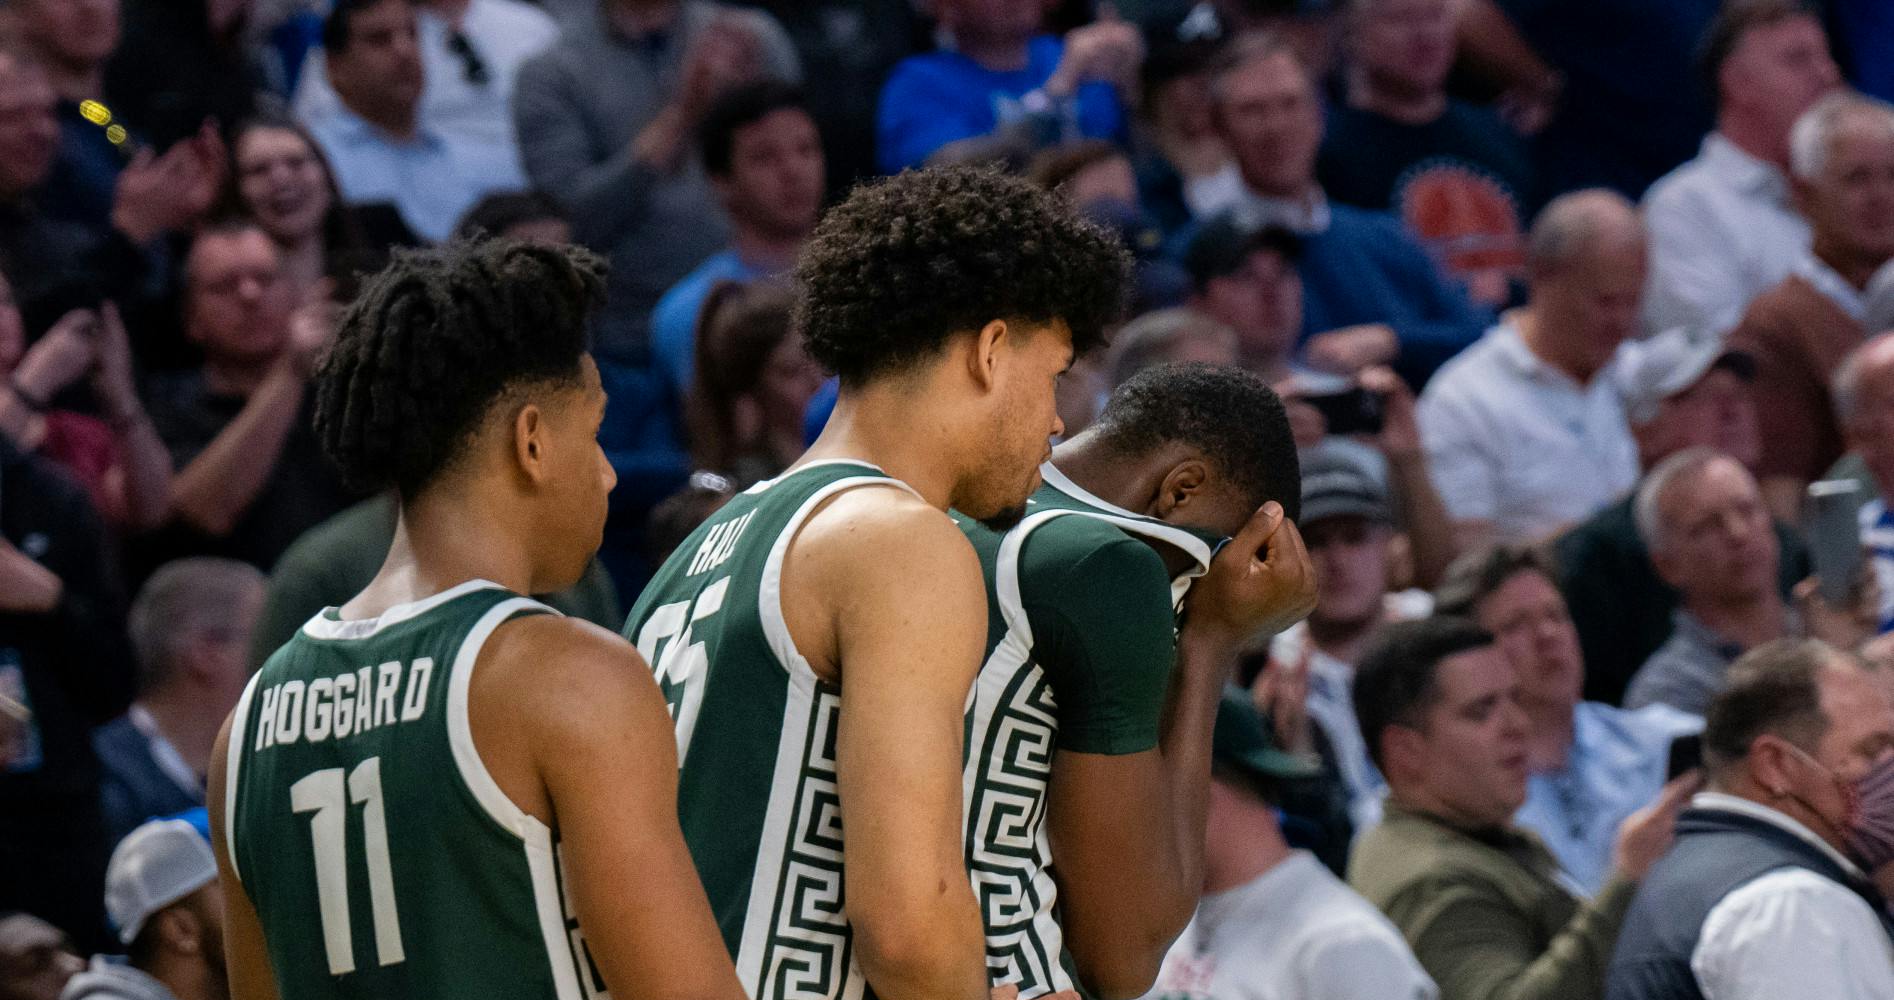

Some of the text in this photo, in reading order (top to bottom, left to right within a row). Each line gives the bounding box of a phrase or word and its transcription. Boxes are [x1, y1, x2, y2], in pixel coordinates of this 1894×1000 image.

[686, 507, 759, 577] HALL
[254, 656, 434, 753] HOGGARD
[290, 755, 406, 976] 11
